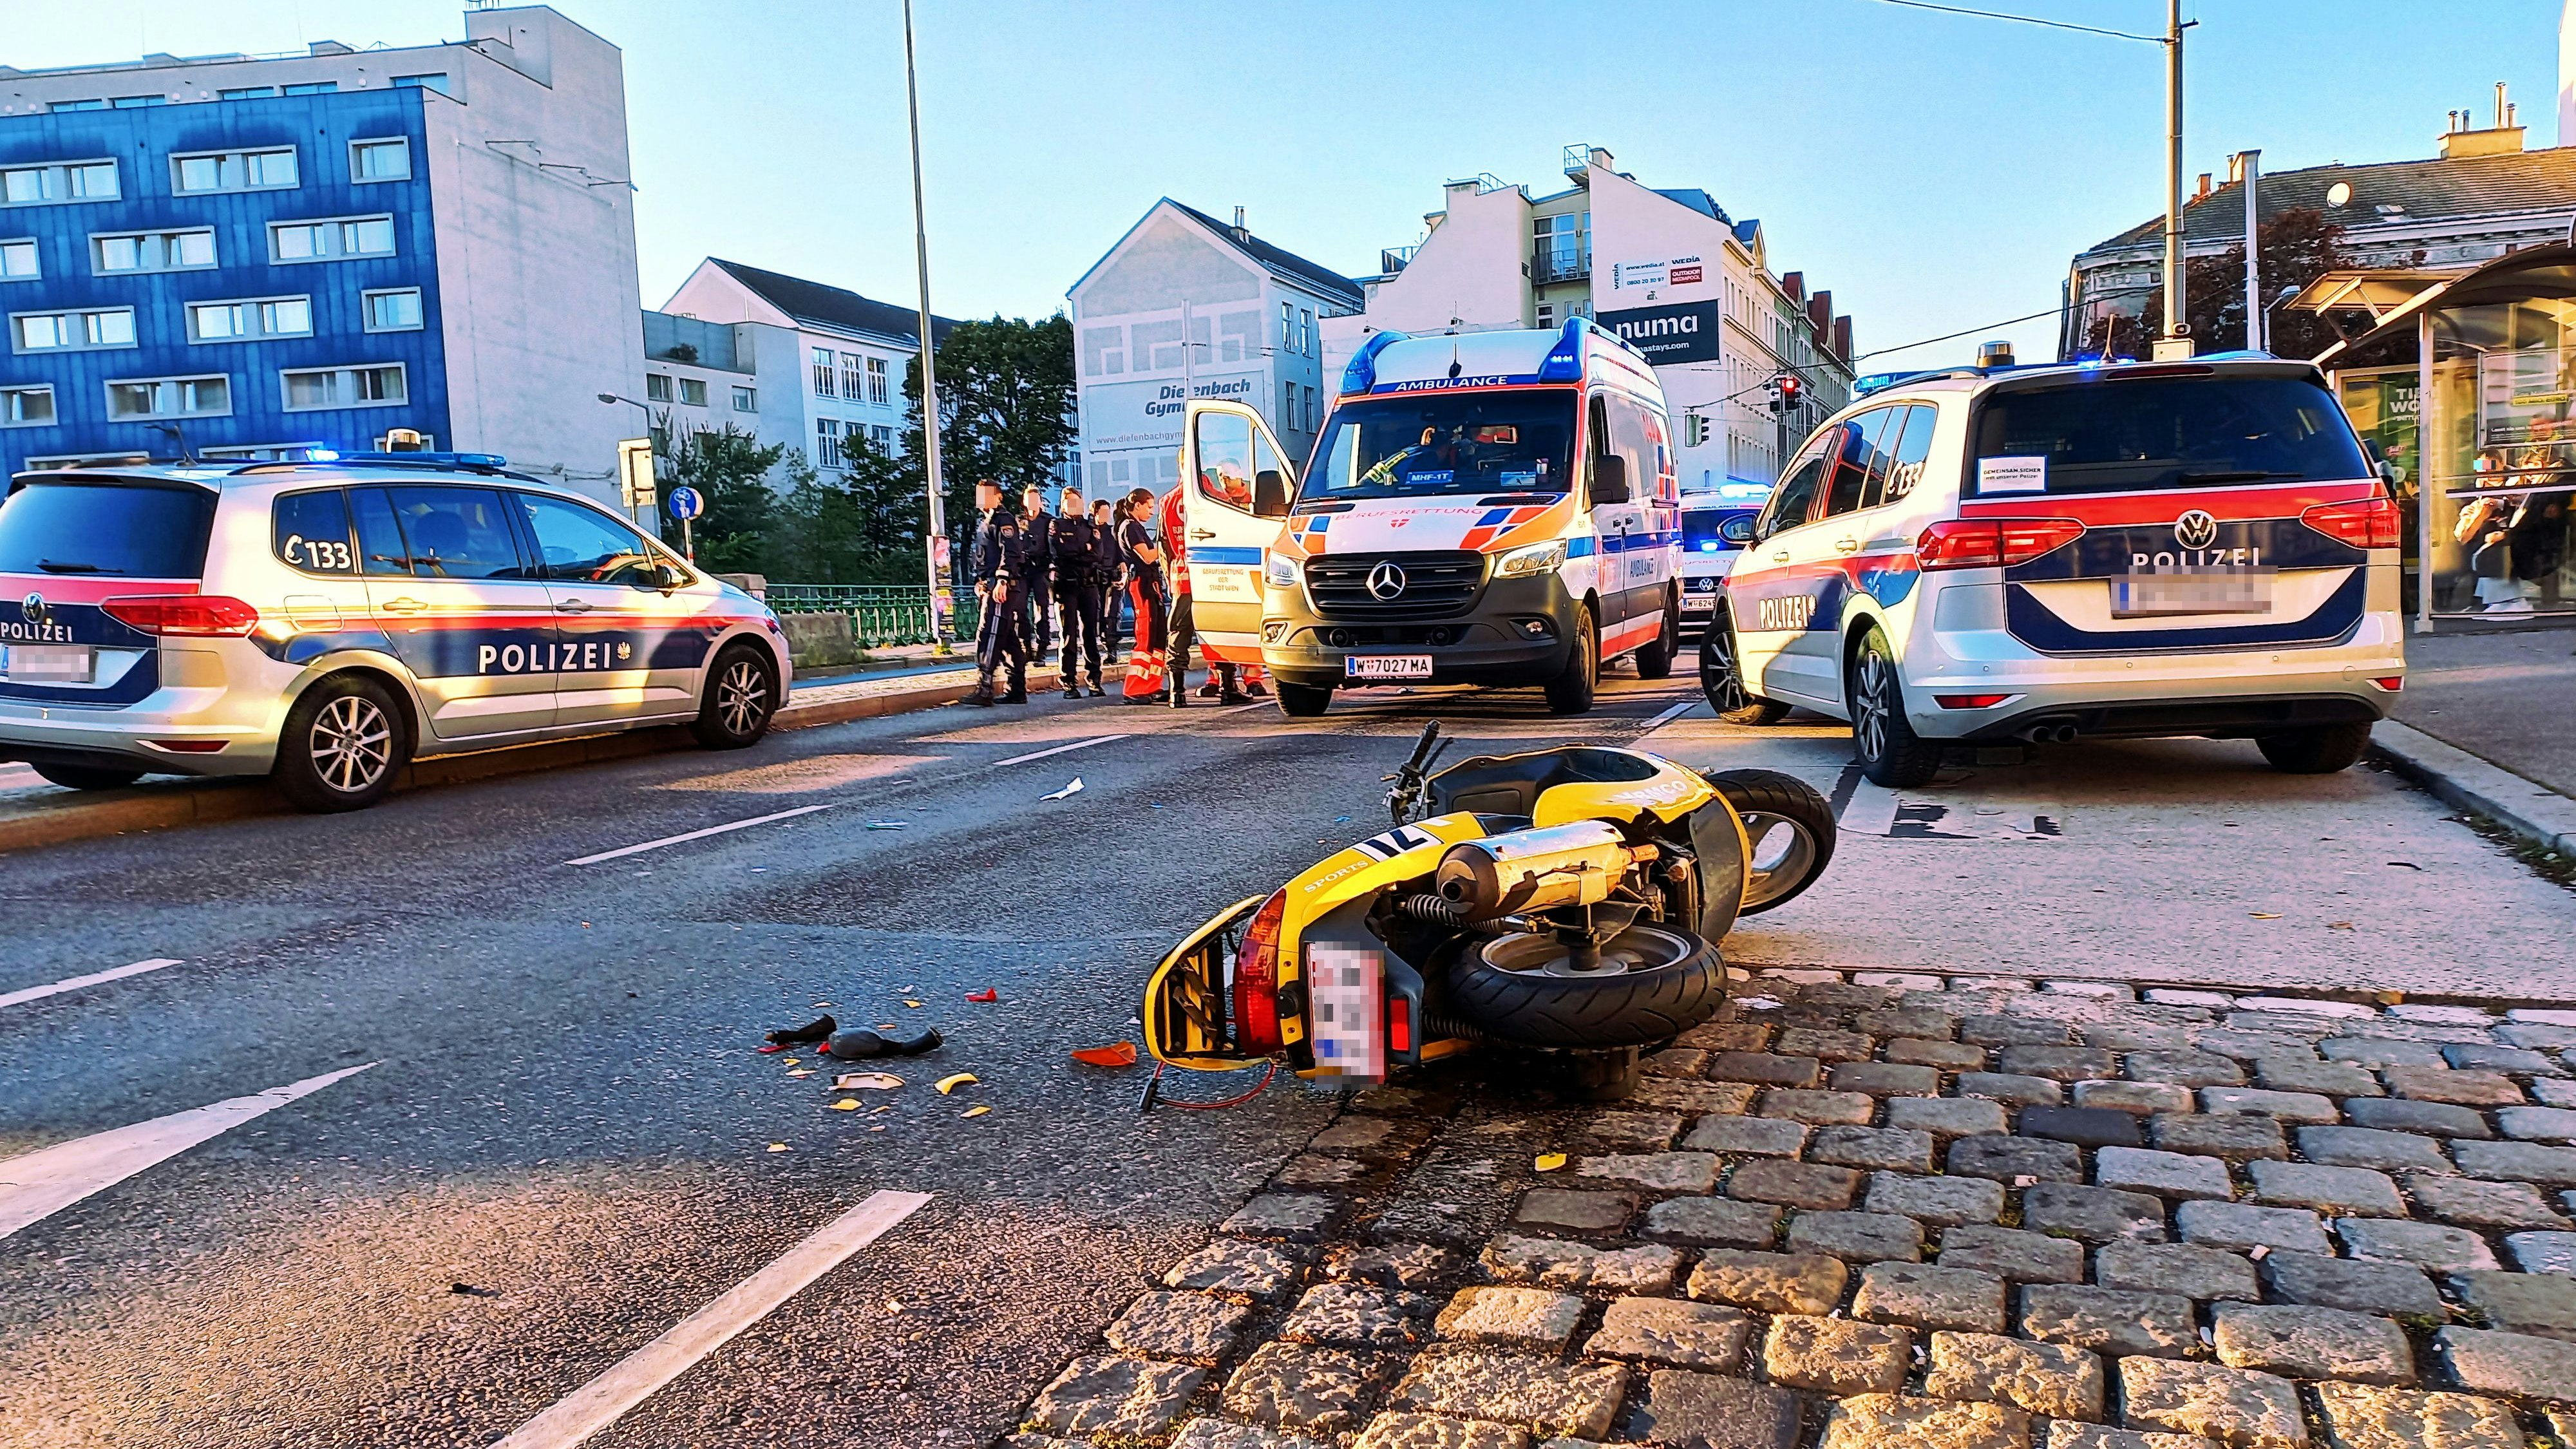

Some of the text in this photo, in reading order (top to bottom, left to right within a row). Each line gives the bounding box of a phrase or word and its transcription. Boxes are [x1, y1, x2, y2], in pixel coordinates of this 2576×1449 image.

[1616, 315, 1698, 339] numa
[1160, 379, 1251, 399] Dieenbach
[1395, 376, 1508, 392] AMBULANCE
[1097, 431, 1184, 444] www.diefenbachgym
[1899, 459, 1926, 495] 133
[1335, 507, 1484, 520] BERUFSRETTUNG
[304, 541, 351, 569] 133
[1759, 595, 1808, 629] POLIZEI
[0, 621, 73, 642] POLIZEI
[478, 642, 611, 674] POLIZEI
[1375, 659, 1407, 672] 7027
[1411, 659, 1428, 672] MA
[1303, 860, 1368, 893] SPORTS
